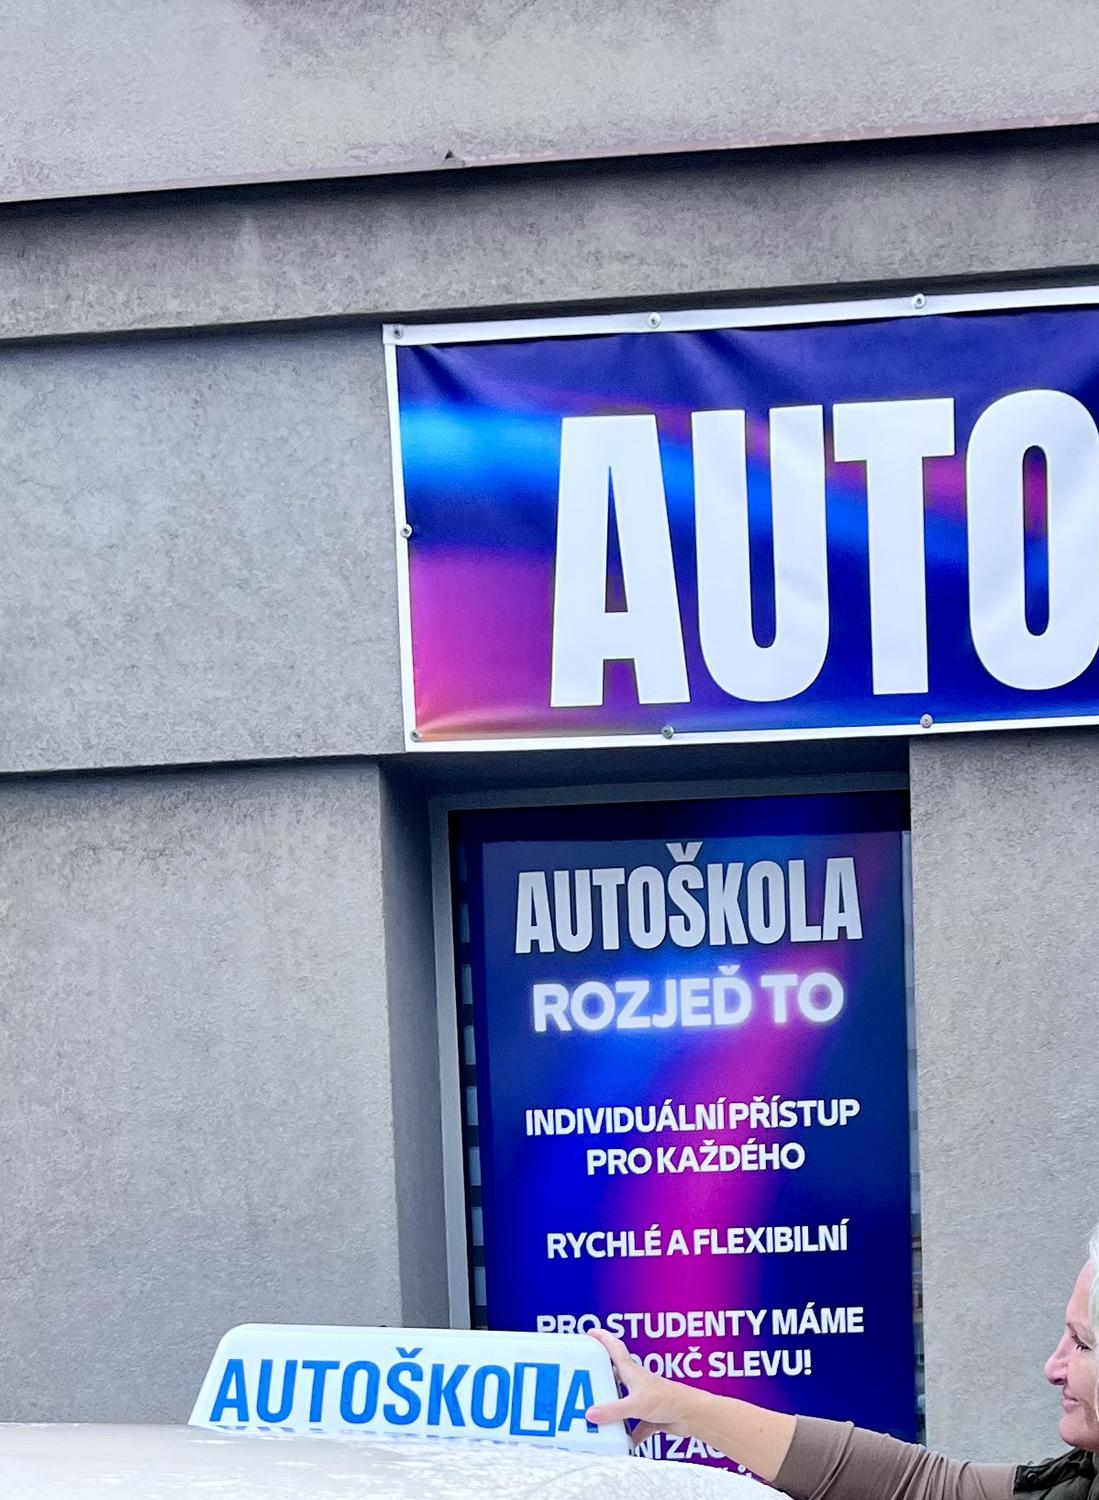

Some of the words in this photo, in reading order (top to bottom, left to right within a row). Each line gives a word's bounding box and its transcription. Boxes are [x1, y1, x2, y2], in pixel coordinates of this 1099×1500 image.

[515, 841, 863, 954] AUTOŠKOLA
[532, 964, 753, 1033] ROZJEĎ
[760, 971, 845, 1025] TO
[525, 1097, 724, 1136] INDIVIDUÁLNÍ
[729, 1096, 861, 1130] PŘÍSTUP
[587, 1148, 653, 1176] PRO
[657, 1139, 806, 1174] KAŽDÉHO
[547, 1224, 664, 1259] RYCHLÉ
[667, 1231, 690, 1256] A
[694, 1218, 850, 1256] FLEXIBILNÍ
[536, 1314, 602, 1334] PRO
[606, 1310, 767, 1339] STUDENTY
[772, 1302, 864, 1335] MÁME
[708, 1349, 812, 1378] SLEVU!
[209, 1347, 600, 1438] AUTOŠKOLA
